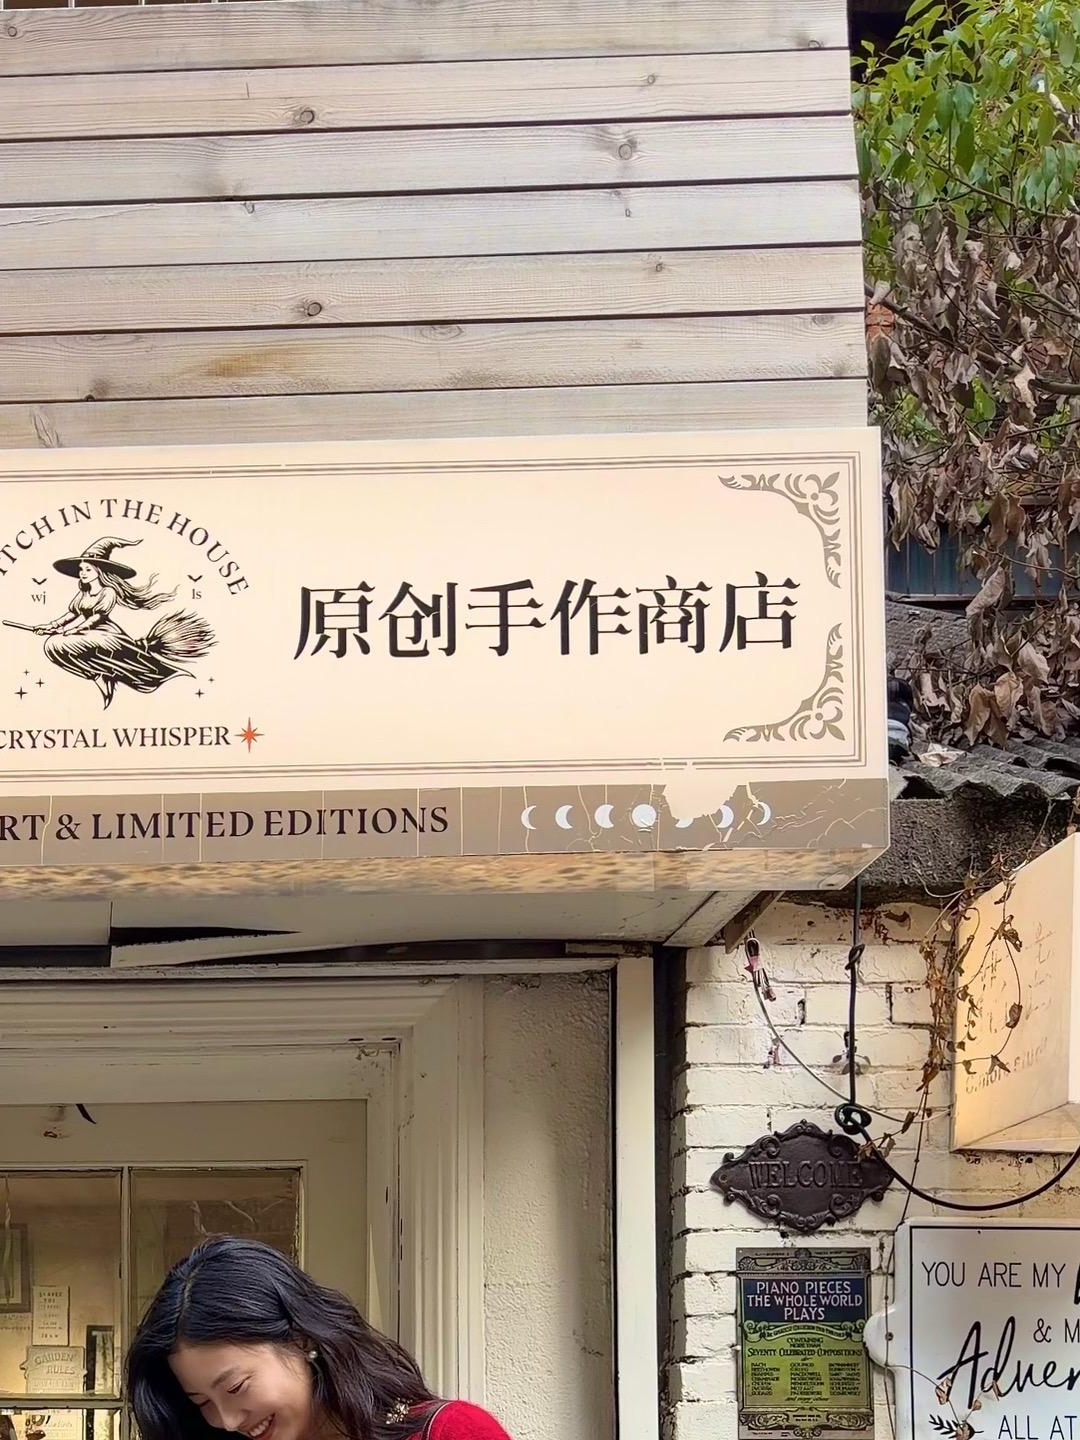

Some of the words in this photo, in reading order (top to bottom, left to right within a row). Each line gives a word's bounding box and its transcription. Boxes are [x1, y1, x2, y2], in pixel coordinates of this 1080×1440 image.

[58, 500, 92, 528] IN
[100, 498, 163, 525] THE
[166, 511, 249, 596] HOUSE
[293, 571, 801, 660] 原创手作商店
[112, 726, 231, 748] WHISPER
[55, 813, 81, 841] &
[92, 810, 254, 840] LIMITED
[263, 806, 449, 837] EDITIONS
[748, 1160, 864, 1190] WELCOME
[921, 1261, 966, 1288] YOU
[977, 1262, 1023, 1288] ARE
[1032, 1262, 1066, 1288] MY
[747, 1294, 771, 1307] THE
[774, 1294, 817, 1307] WHOLE
[819, 1294, 863, 1307] WORLD
[756, 1281, 800, 1295] PIANO
[805, 1281, 852, 1294] PIECES
[784, 1307, 825, 1321] PLAYS
[1032, 1317, 1052, 1344] &
[747, 1348, 777, 1357] SEVENTY
[997, 1414, 1039, 1440] ALL
[1049, 1414, 1078, 1440] AT
